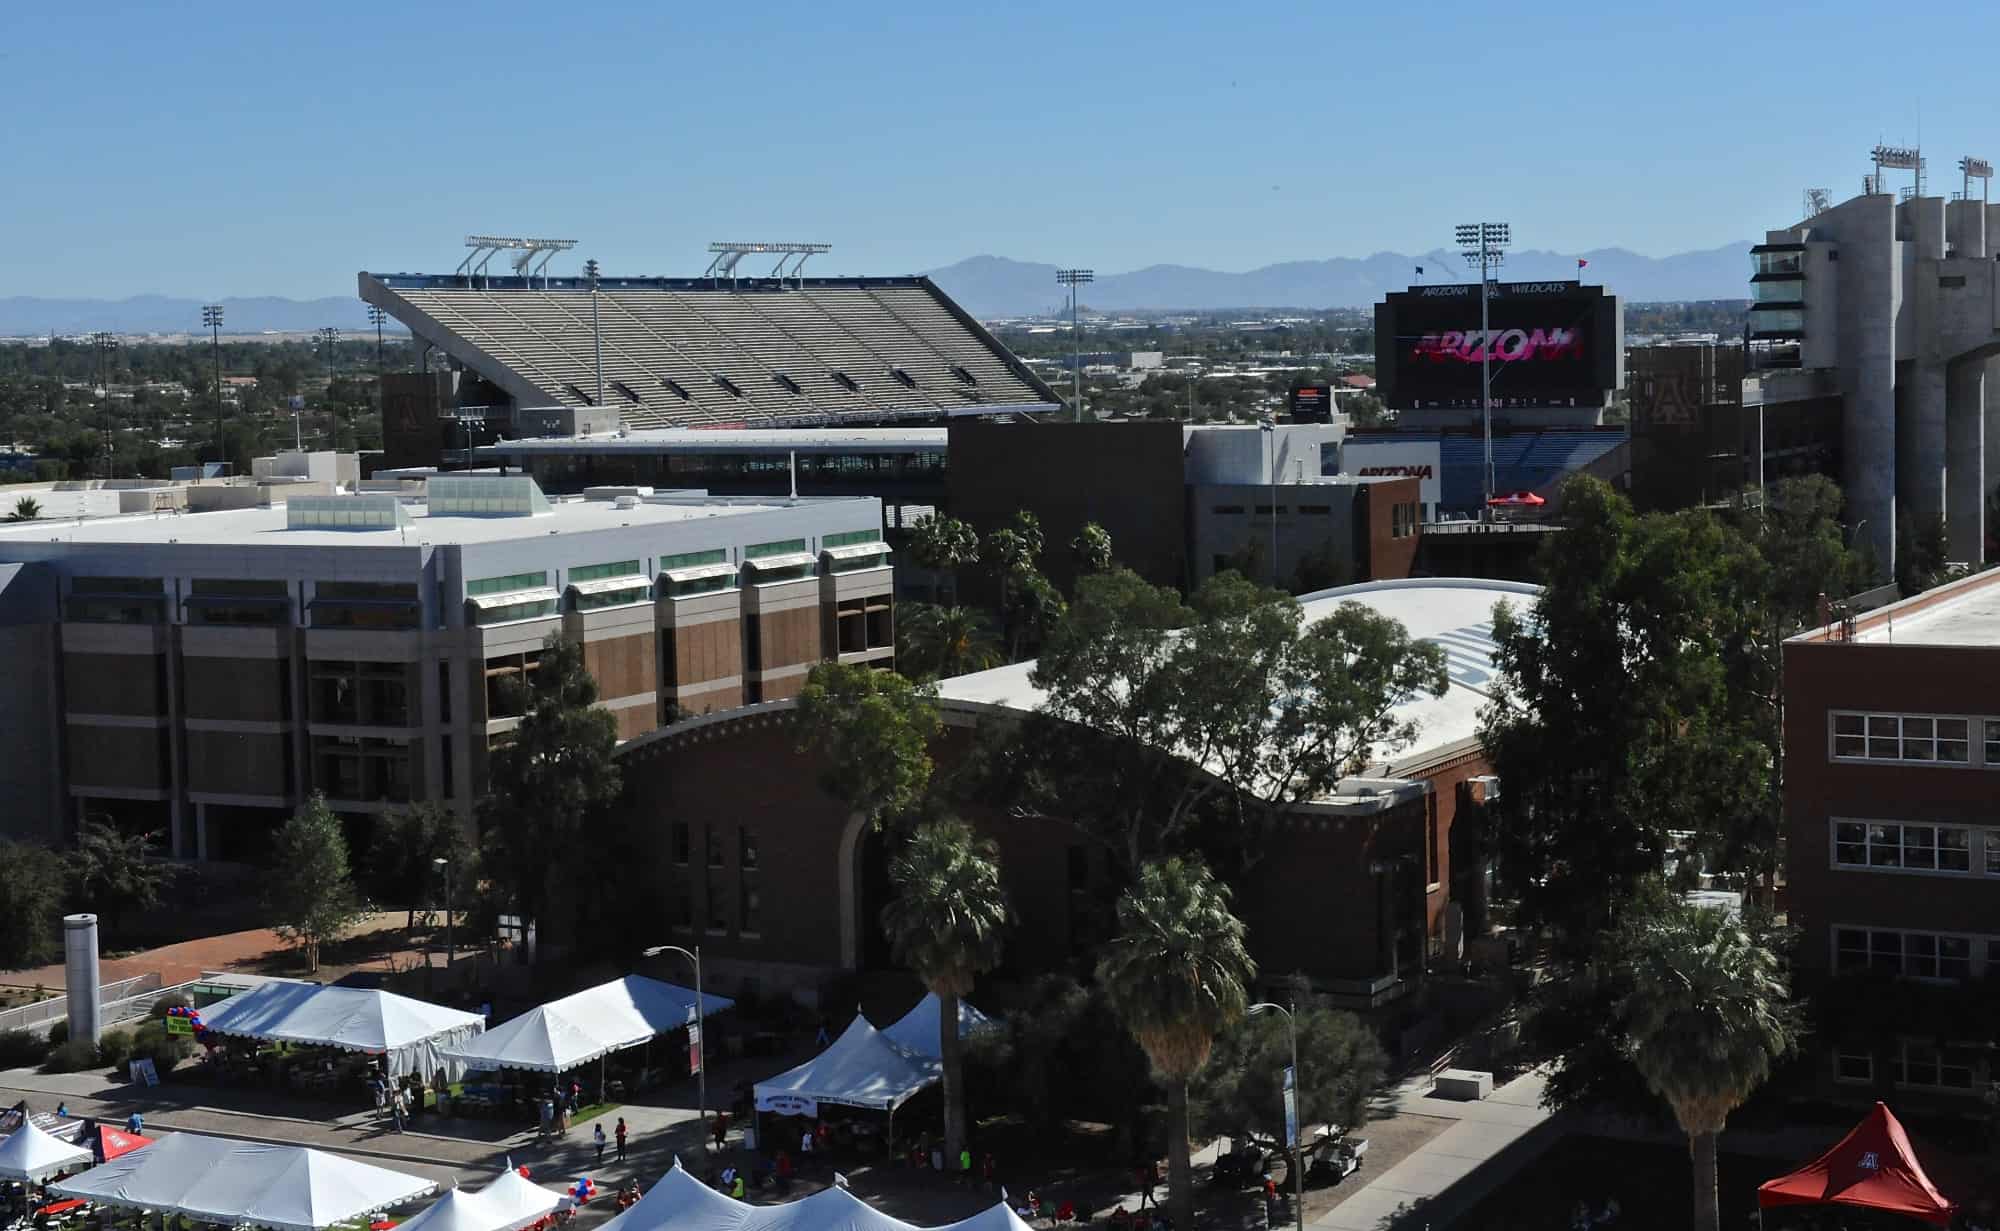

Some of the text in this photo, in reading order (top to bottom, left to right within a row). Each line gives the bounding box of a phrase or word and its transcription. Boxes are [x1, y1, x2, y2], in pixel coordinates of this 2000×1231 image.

[1421, 286, 1470, 297] ARIZONA
[1511, 283, 1567, 295] WILDCATS
[1359, 465, 1433, 480] ARIZONA
